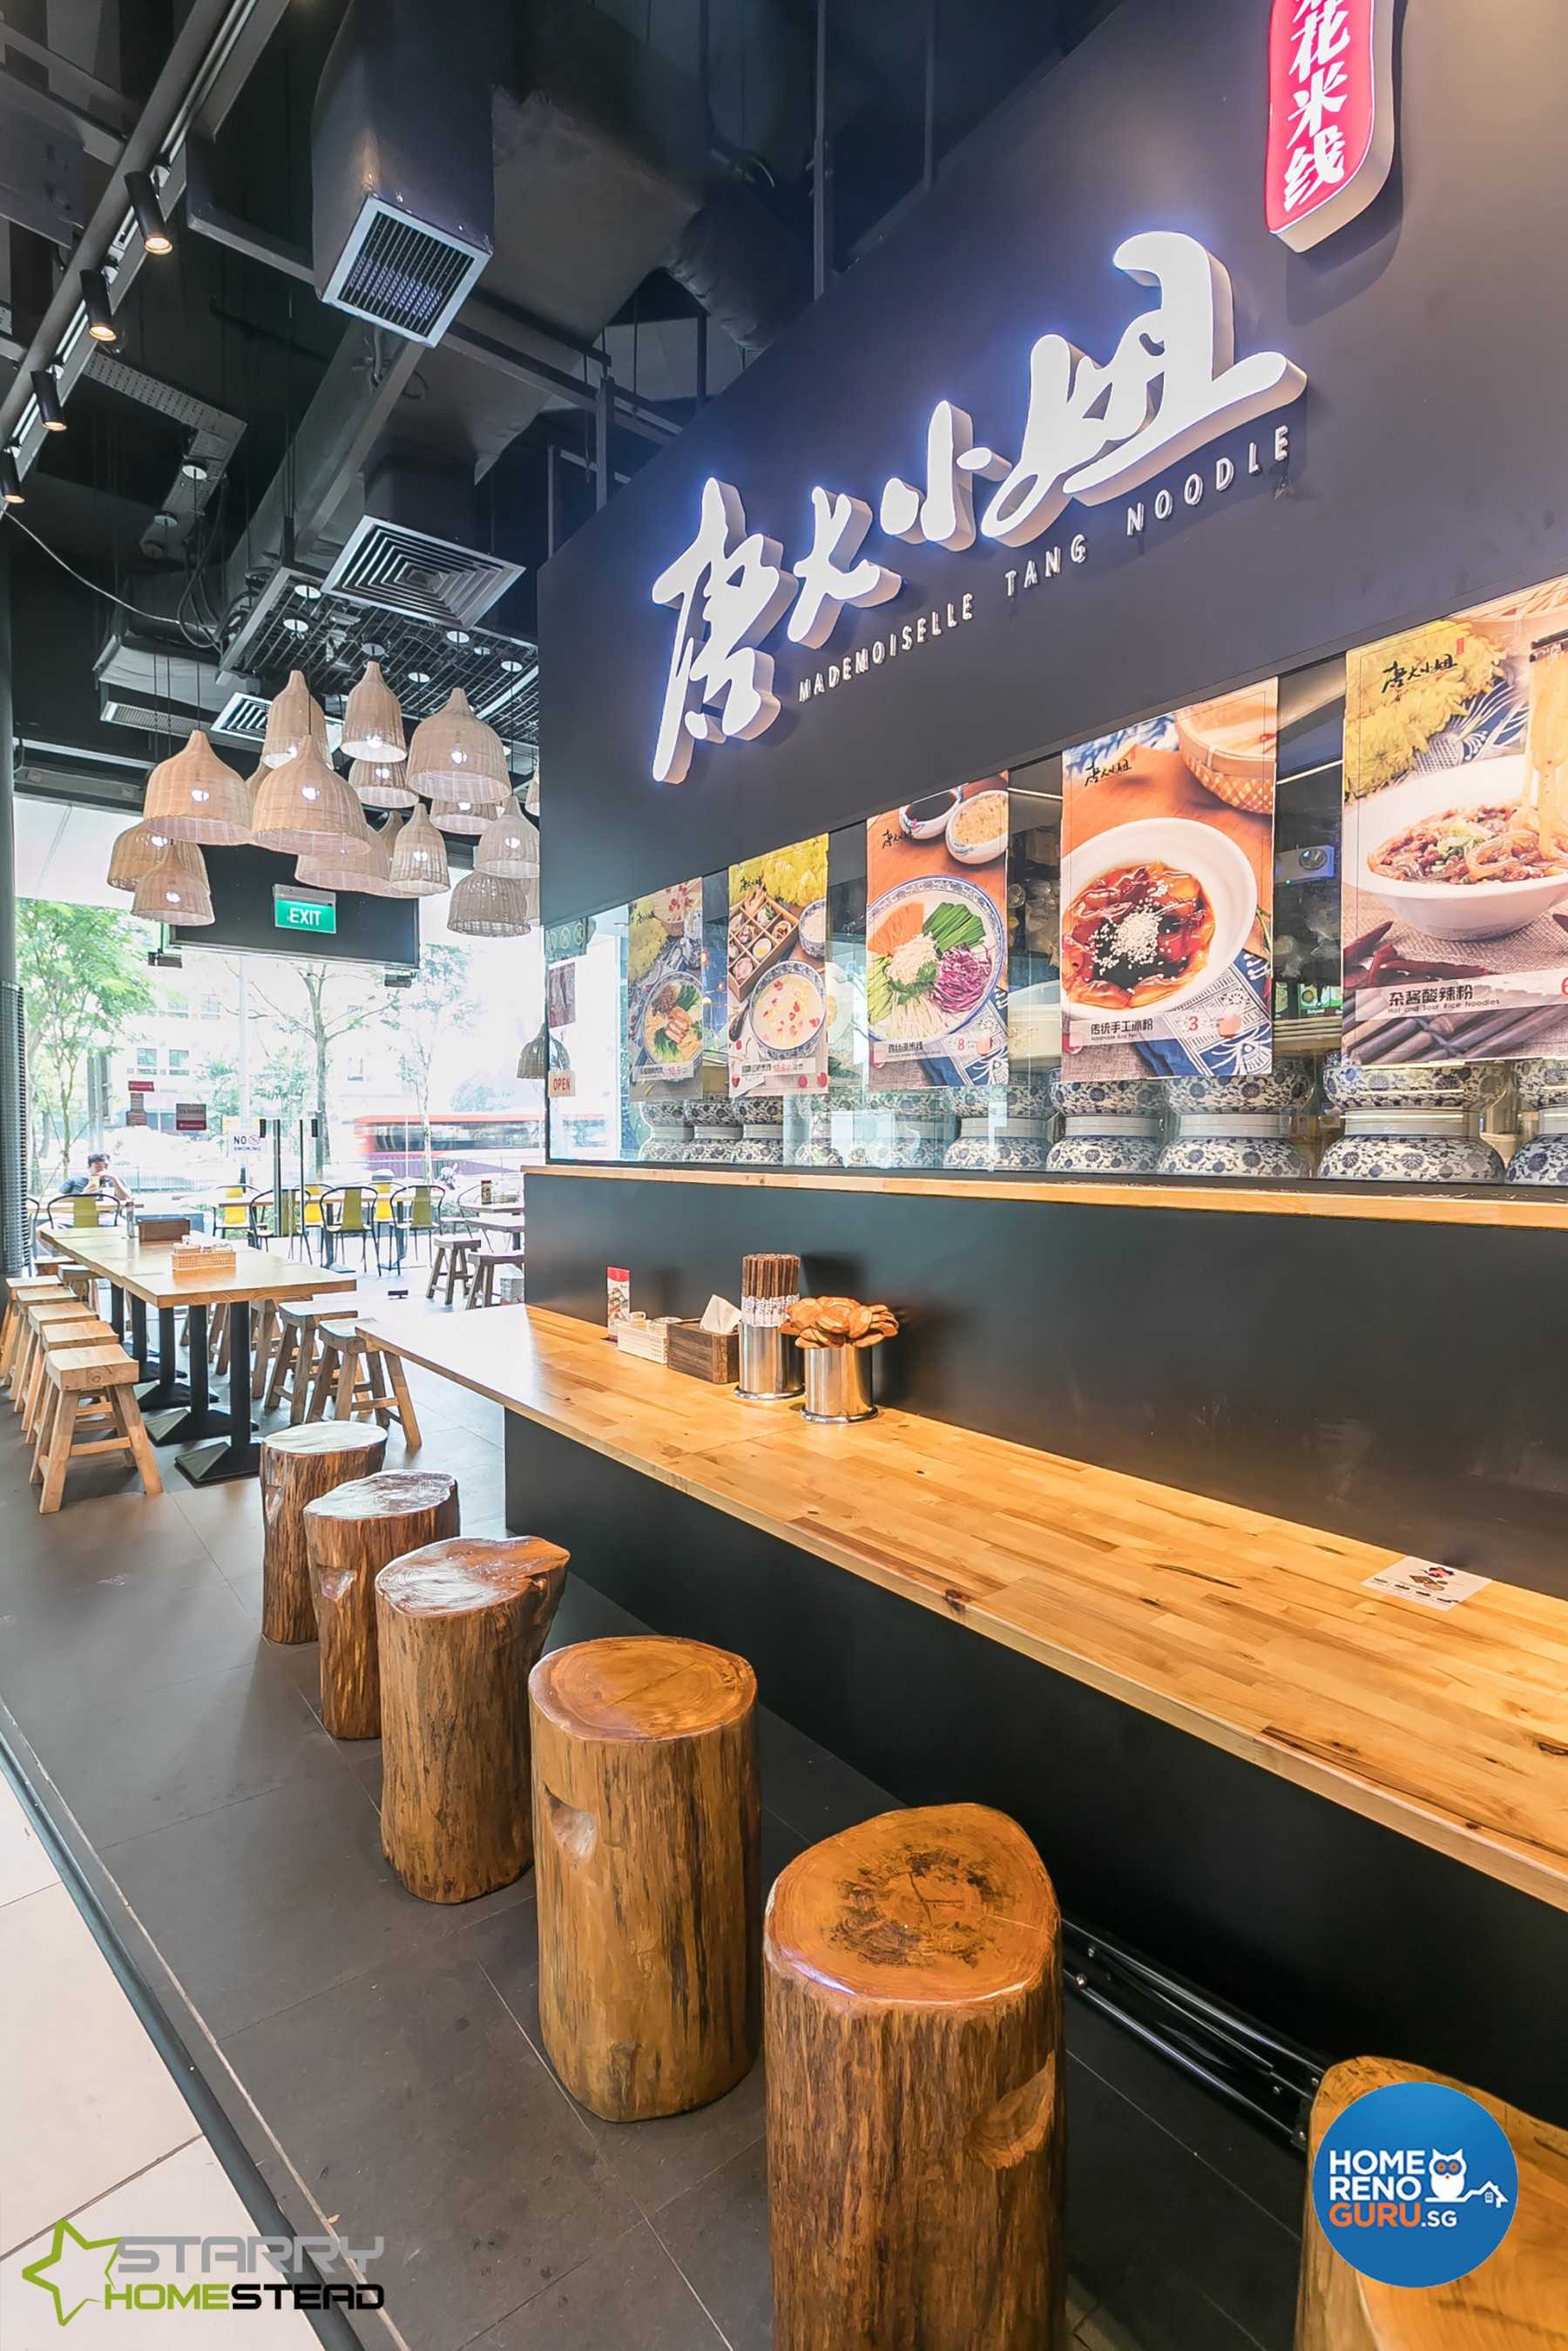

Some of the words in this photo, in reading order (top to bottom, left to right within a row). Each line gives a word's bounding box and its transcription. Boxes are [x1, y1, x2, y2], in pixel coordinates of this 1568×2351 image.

[1283, 0, 1351, 212] 花米线
[798, 592, 974, 703] MADEMOISELLE
[1004, 533, 1087, 597] TANG
[1126, 424, 1289, 537] NOODLE
[289, 907, 321, 927] EXIT
[1389, 984, 1473, 1007] 杂酱酸辣粉
[1465, 998, 1501, 1008] Noodles
[1091, 1017, 1153, 1036] 传统手工冰粉
[1188, 1016, 1199, 1031] 3
[957, 1037, 965, 1051] 8
[553, 1078, 571, 1091] OPEN
[233, 1135, 247, 1145] NO
